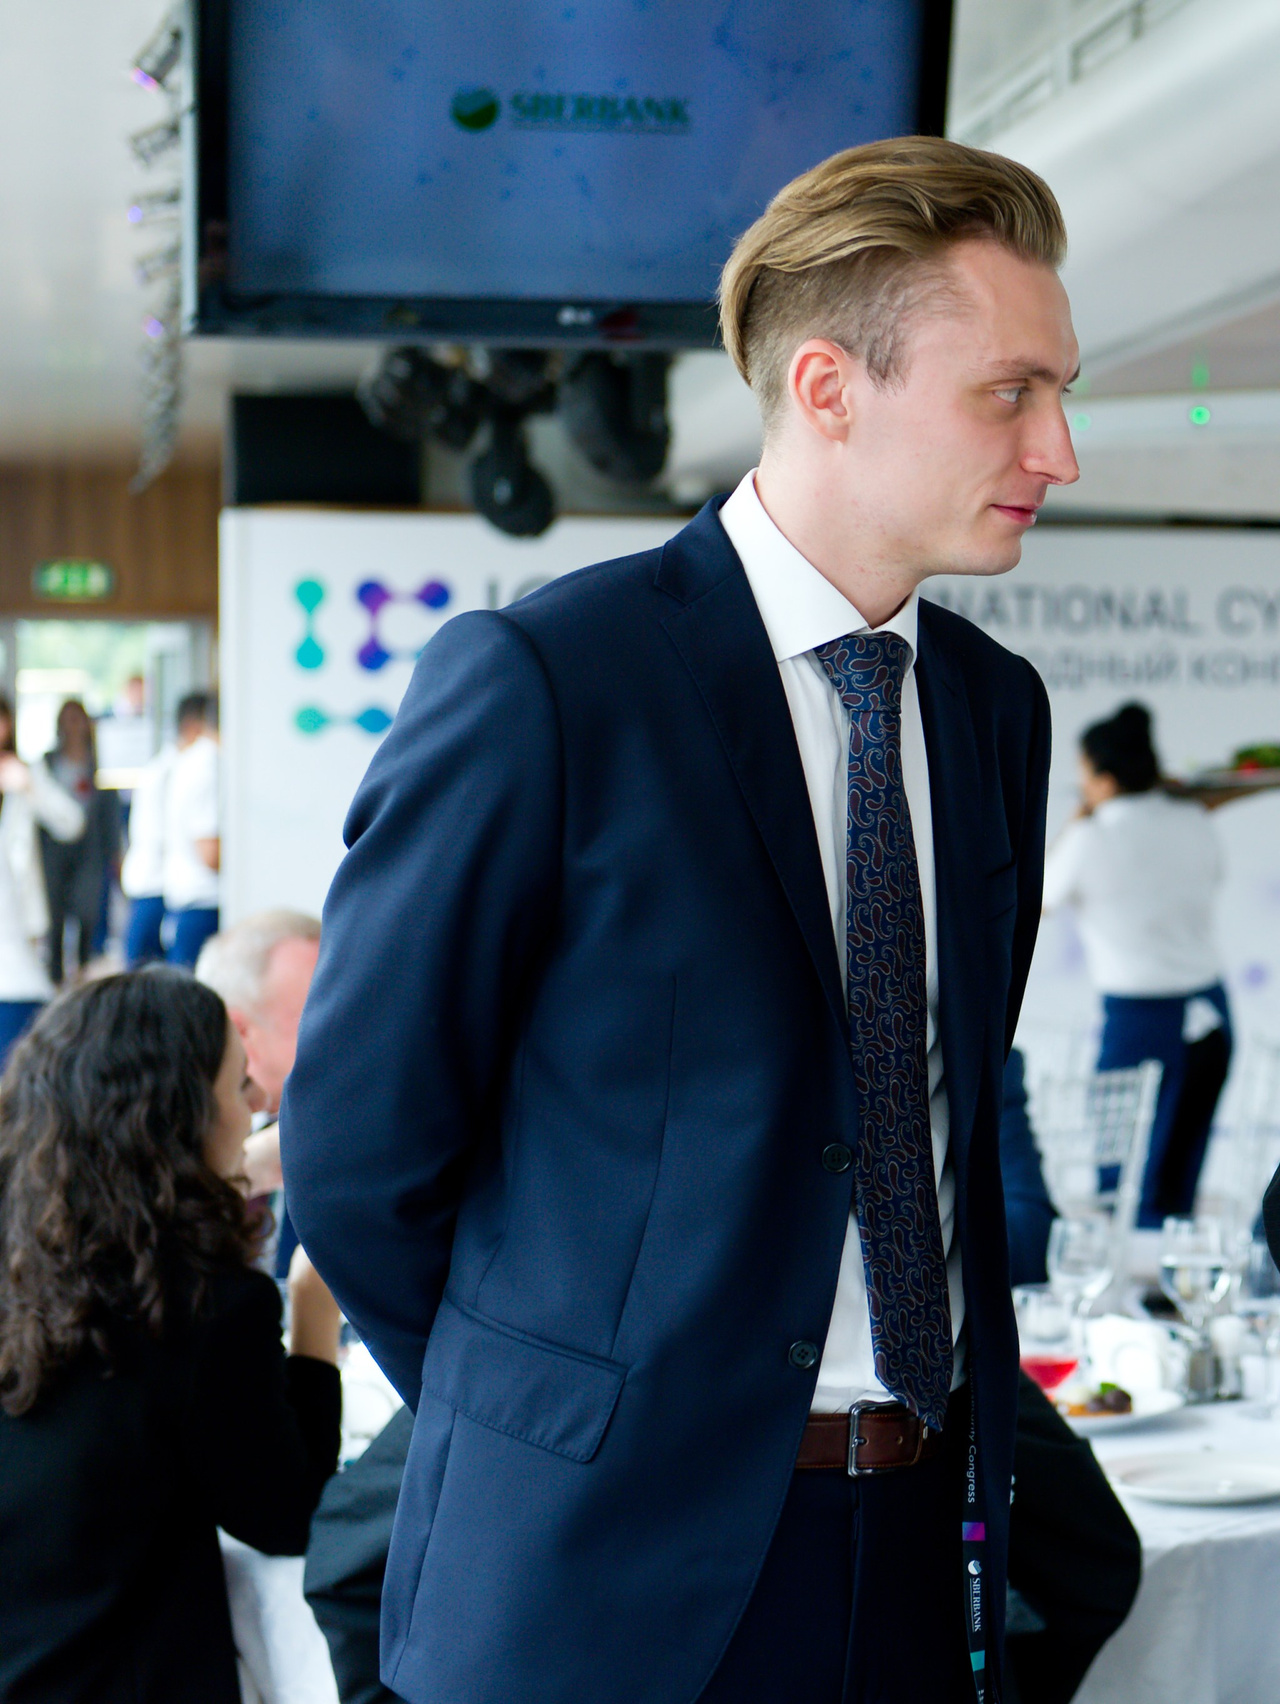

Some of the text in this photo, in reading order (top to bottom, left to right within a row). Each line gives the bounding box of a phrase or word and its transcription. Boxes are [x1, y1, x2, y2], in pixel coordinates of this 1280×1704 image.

[921, 584, 1206, 637] NATIONAL
[966, 1445, 977, 1504] Congress
[971, 1577, 982, 1632] SBERBANK
